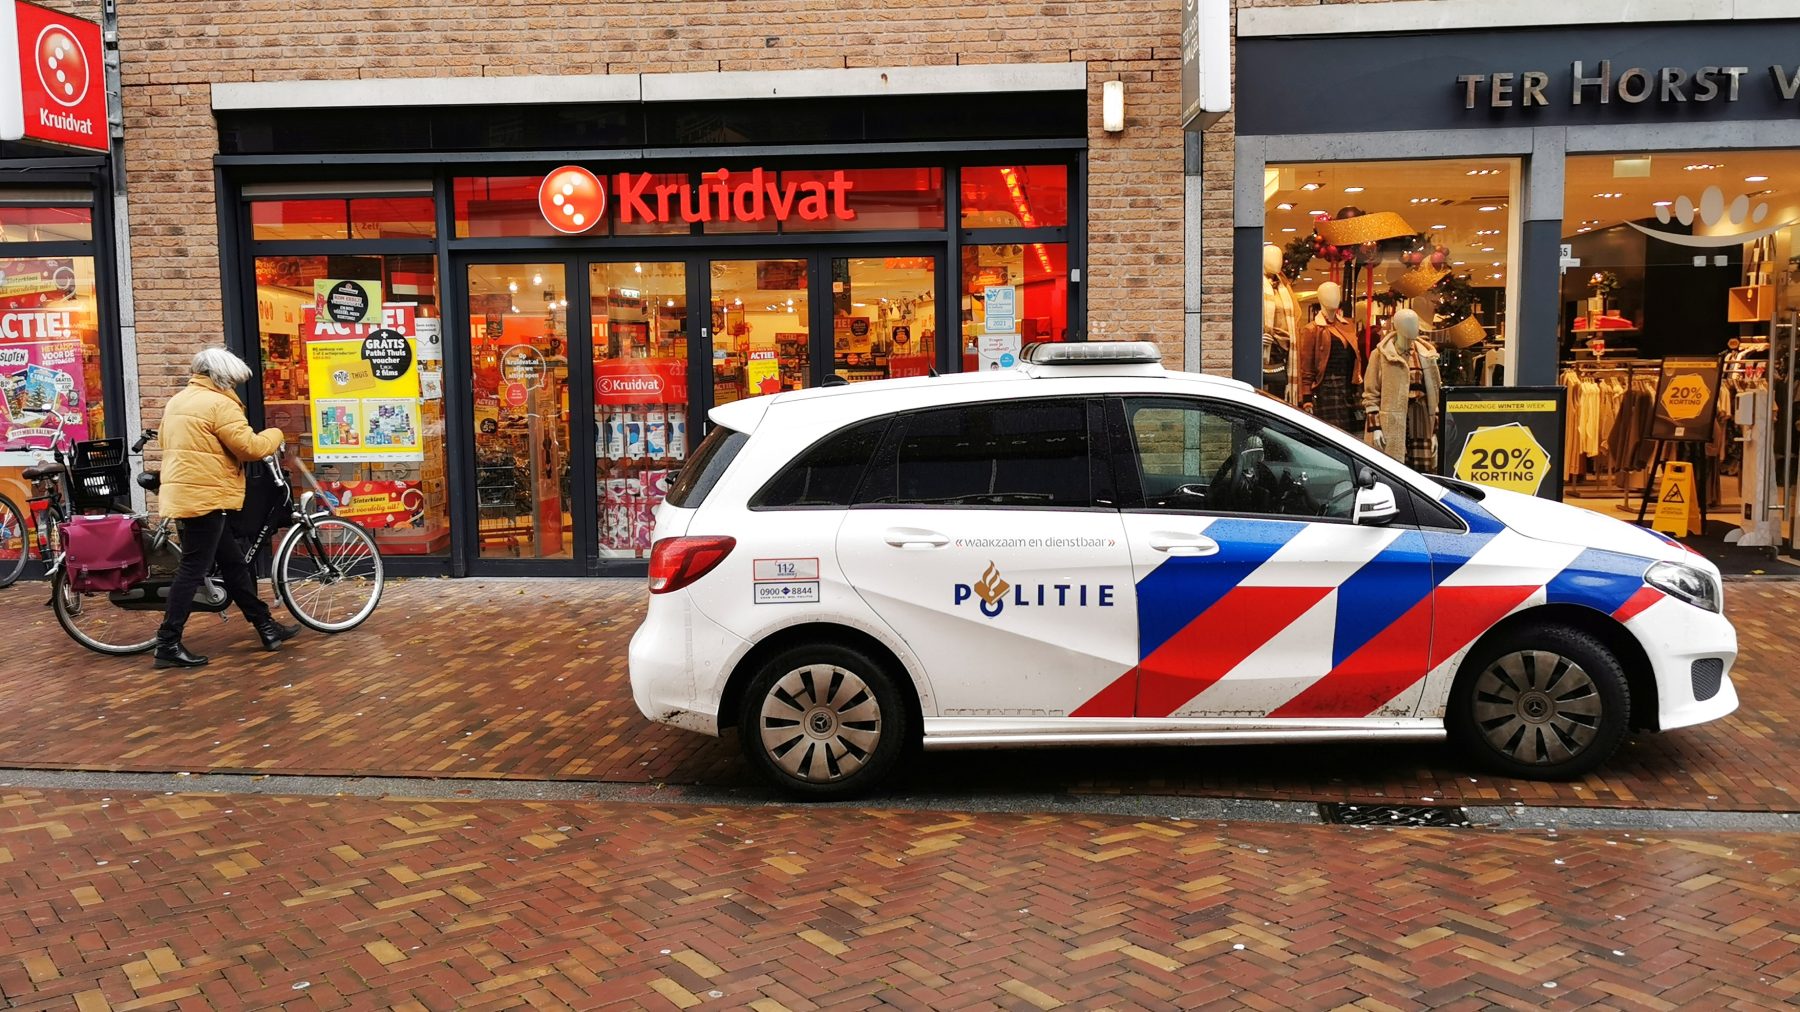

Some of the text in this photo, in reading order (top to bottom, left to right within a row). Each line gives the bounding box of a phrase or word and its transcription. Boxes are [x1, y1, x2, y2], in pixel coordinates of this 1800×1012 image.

[1457, 71, 1549, 109] TER
[1571, 59, 1749, 105] HORST
[40, 107, 93, 135] Kruidvat
[618, 167, 856, 223] Kruidvat
[365, 339, 405, 349] GRATIS
[42, 352, 64, 360] VOOR
[365, 349, 406, 357] Pathé Thuis
[372, 356, 400, 364] voucher
[381, 368, 398, 376] films
[613, 378, 660, 390] Kruidvat
[1670, 386, 1703, 399] 20%
[1471, 448, 1534, 470] 20%
[1471, 471, 1534, 482] KORTING
[1028, 538, 1043, 548] en
[777, 563, 795, 573] 112
[760, 587, 812, 598] 0900 8844
[954, 582, 1115, 618] POLITIE
